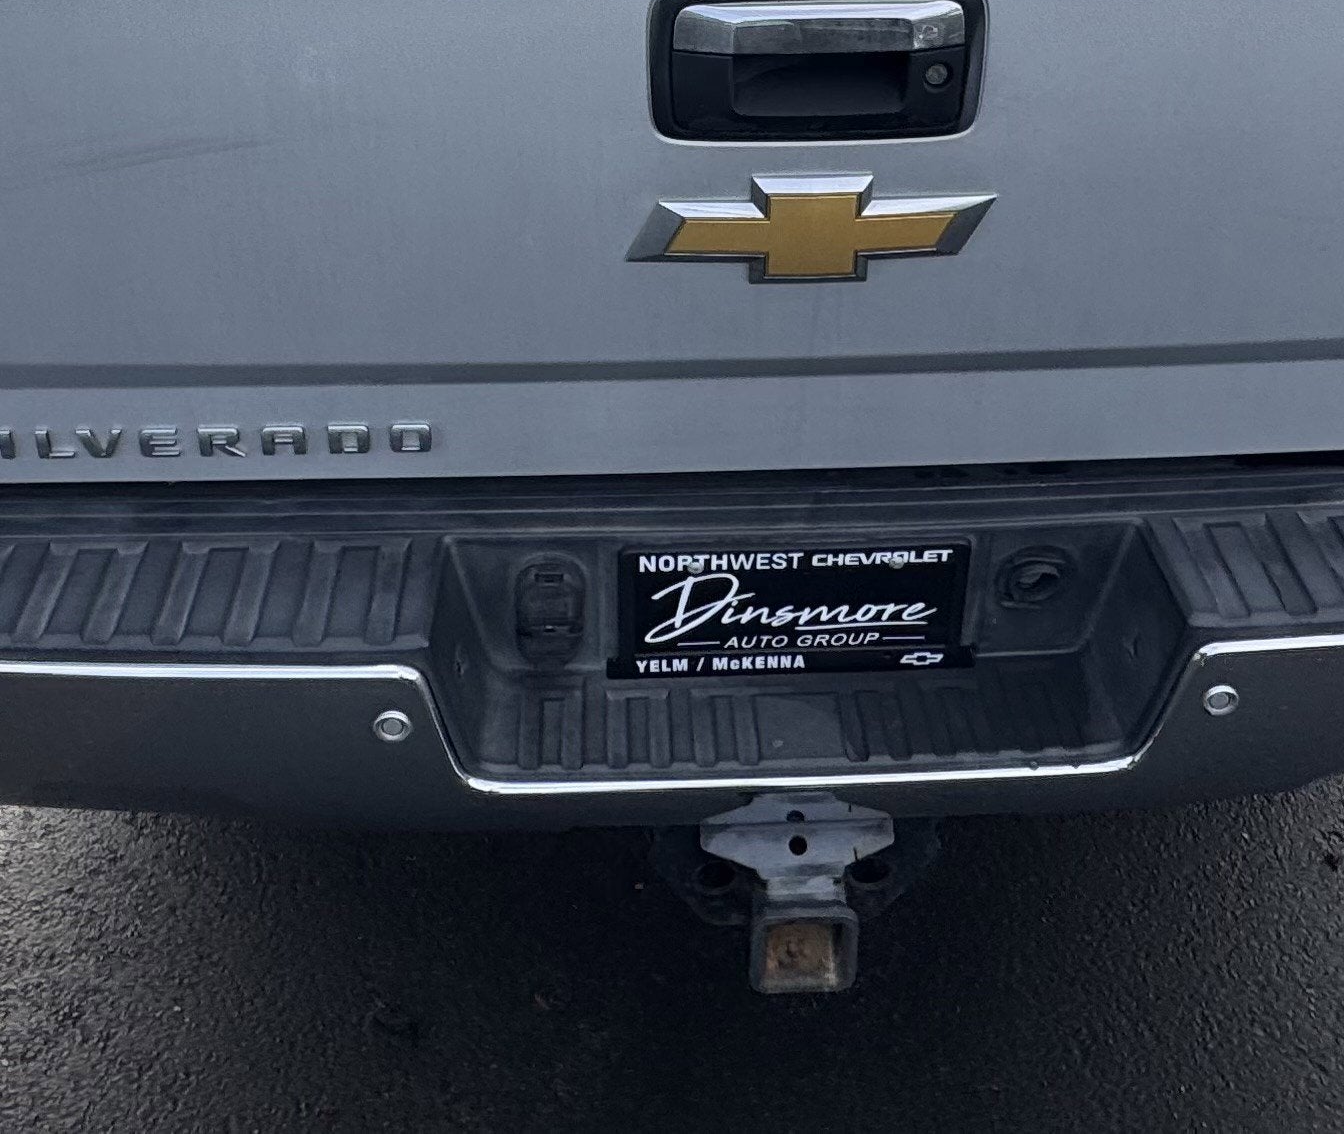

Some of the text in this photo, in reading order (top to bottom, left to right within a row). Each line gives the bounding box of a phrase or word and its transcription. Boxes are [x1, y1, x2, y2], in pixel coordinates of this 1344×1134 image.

[639, 549, 954, 573] NORTHWEST CHEVROLET
[644, 573, 938, 643] Dinsmore
[724, 632, 880, 648] AUTO GROUP
[636, 658, 689, 673] YELM
[712, 654, 806, 670] McKENNA
